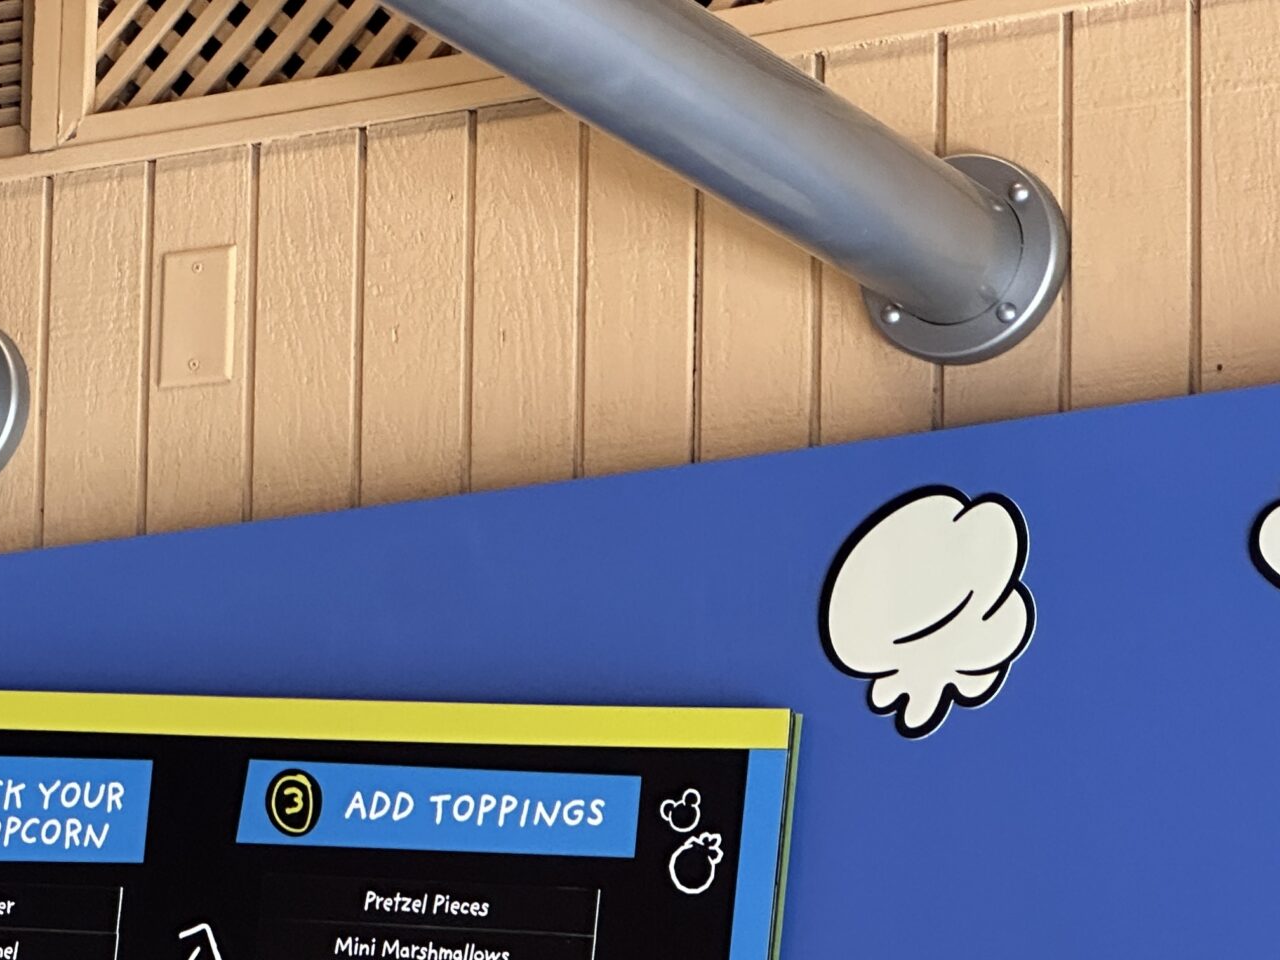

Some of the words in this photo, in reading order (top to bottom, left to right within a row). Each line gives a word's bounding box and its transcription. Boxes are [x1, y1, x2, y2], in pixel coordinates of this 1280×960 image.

[38, 779, 125, 813] YOUR
[284, 787, 304, 815] 3
[344, 791, 414, 822] ADD
[430, 794, 605, 828] TOPPINGS
[364, 890, 428, 915] Pretzel
[432, 894, 490, 917] Pieces
[334, 937, 376, 957] Mini
